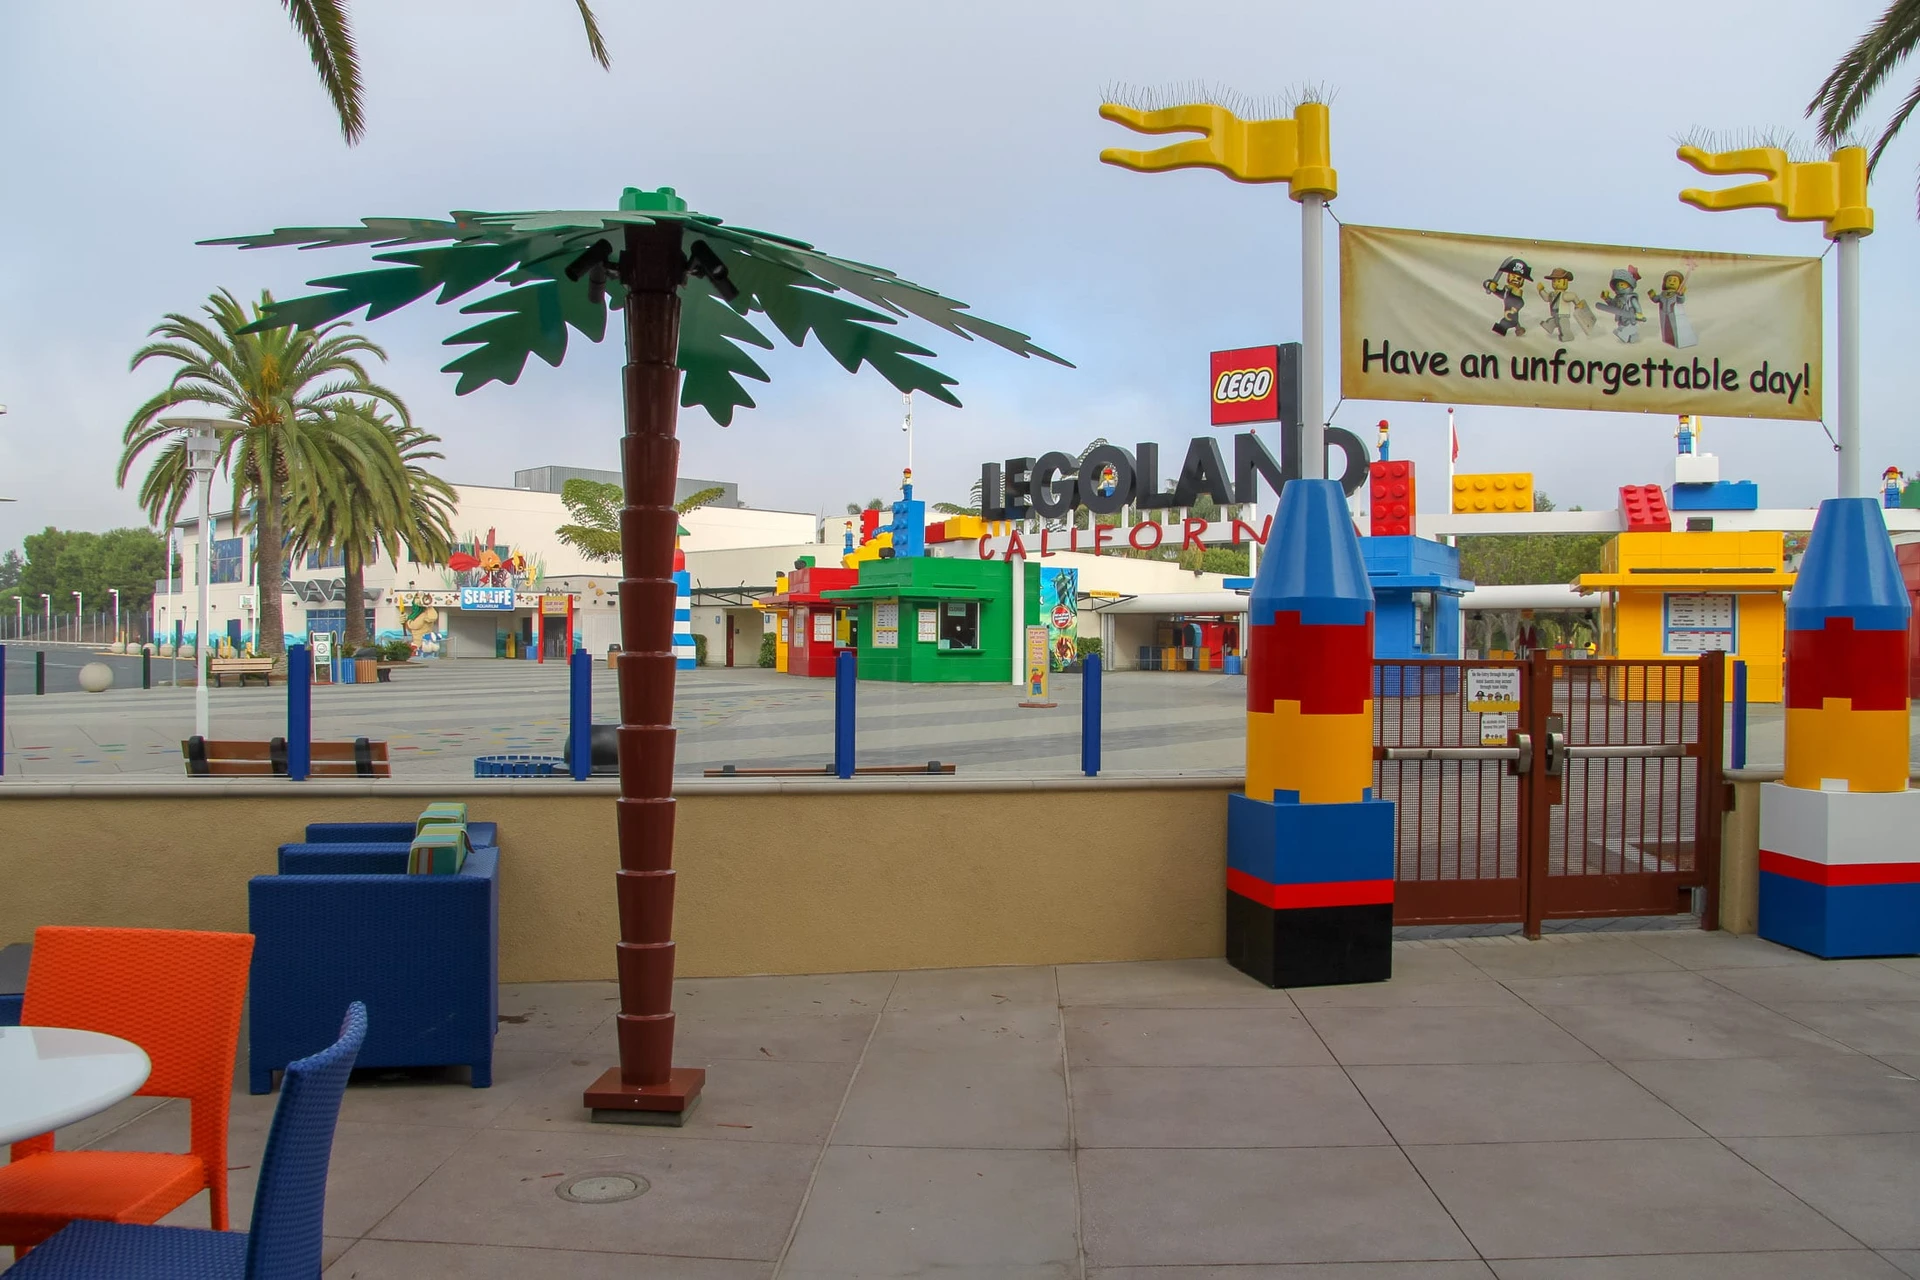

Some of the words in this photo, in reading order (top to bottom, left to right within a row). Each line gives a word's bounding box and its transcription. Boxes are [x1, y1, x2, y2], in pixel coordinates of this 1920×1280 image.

[1216, 370, 1271, 400] LEGO
[1361, 338, 1450, 376] Have
[1460, 348, 1500, 380] an
[1510, 348, 1739, 396] unforgettable
[1749, 361, 1811, 405] day!
[981, 427, 1370, 521] LEGOLAND
[979, 514, 1362, 561] CALIFORN
[464, 589, 487, 604] SEA
